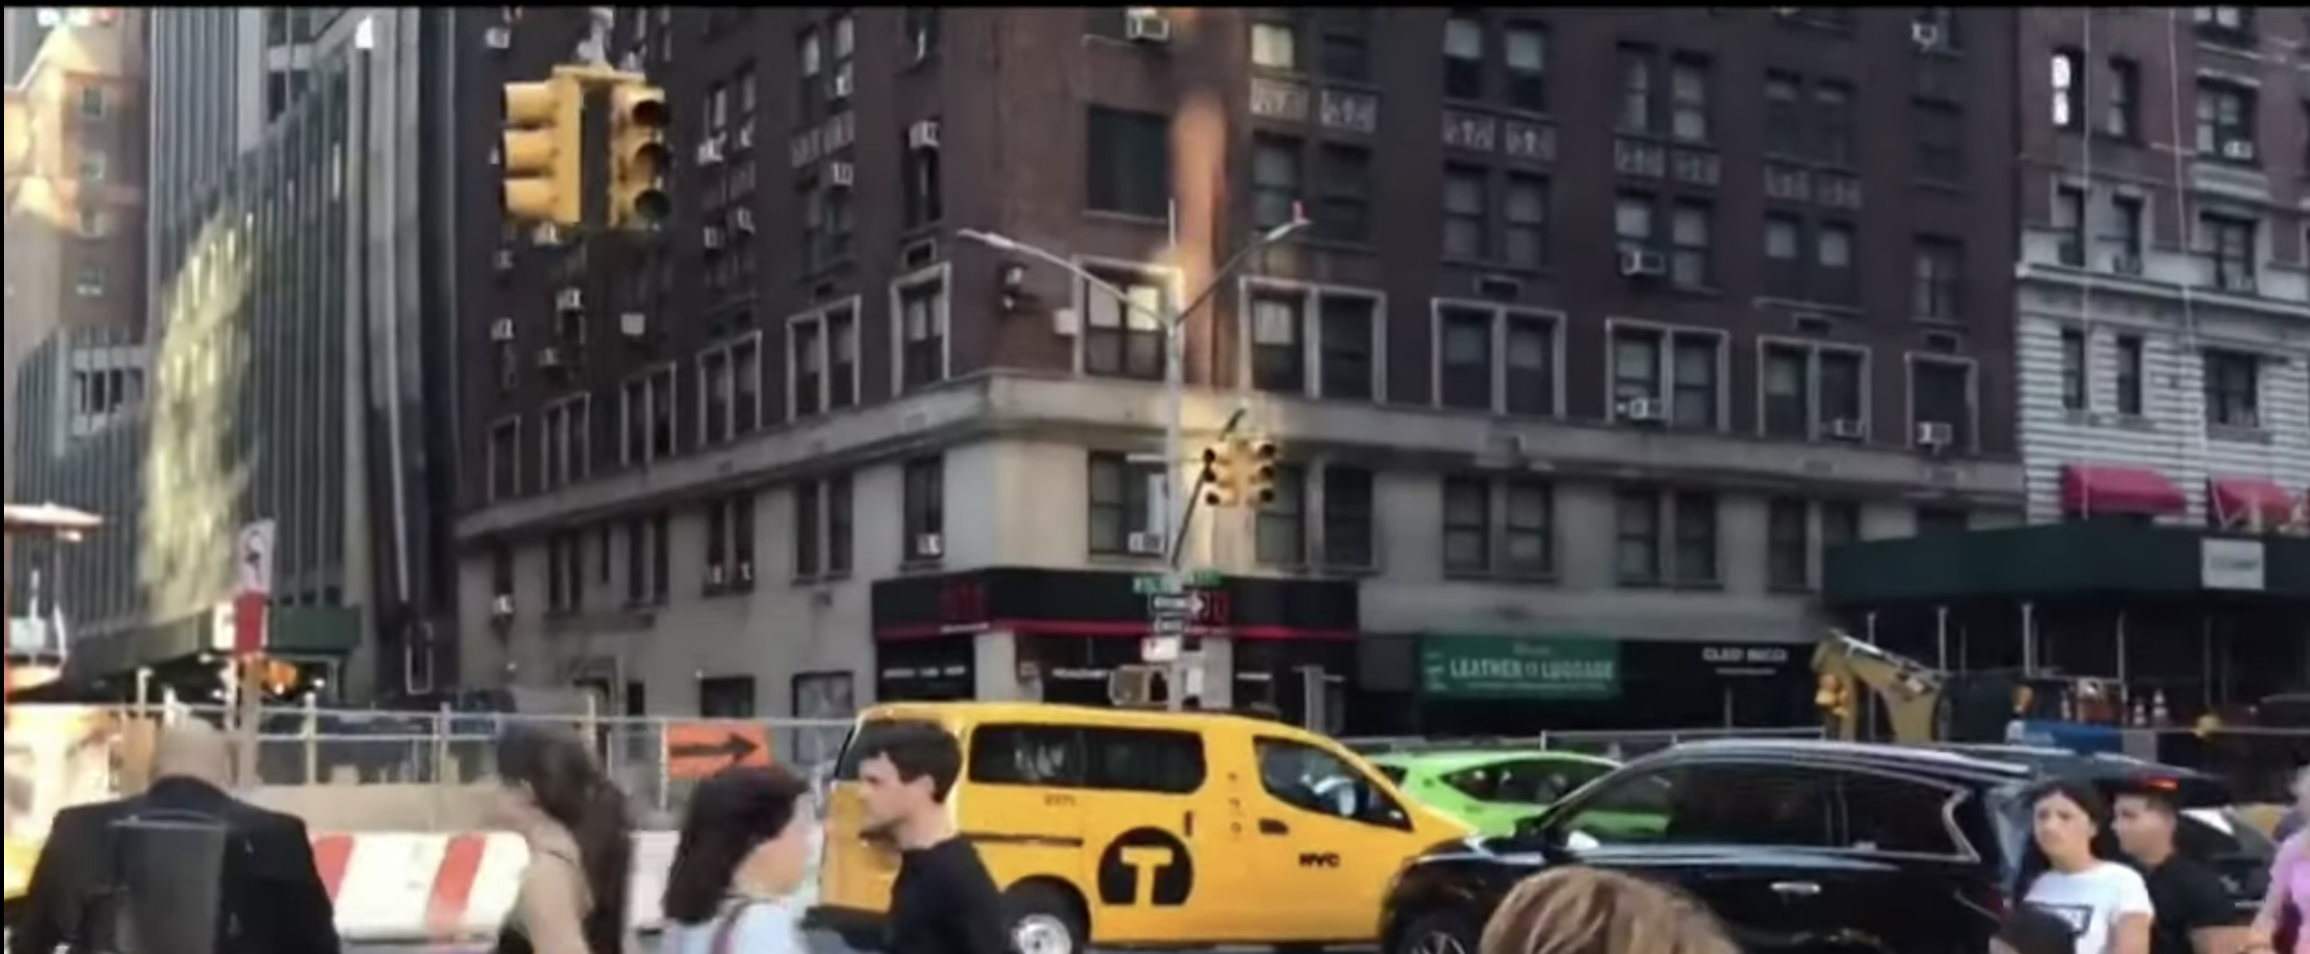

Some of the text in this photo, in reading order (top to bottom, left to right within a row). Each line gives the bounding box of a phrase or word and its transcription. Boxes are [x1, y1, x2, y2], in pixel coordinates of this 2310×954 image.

[1450, 658, 1523, 678] LEATHER
[1541, 659, 1615, 681] LUGGAGE
[1299, 852, 1341, 868] NYC
[1121, 846, 1172, 905] T
